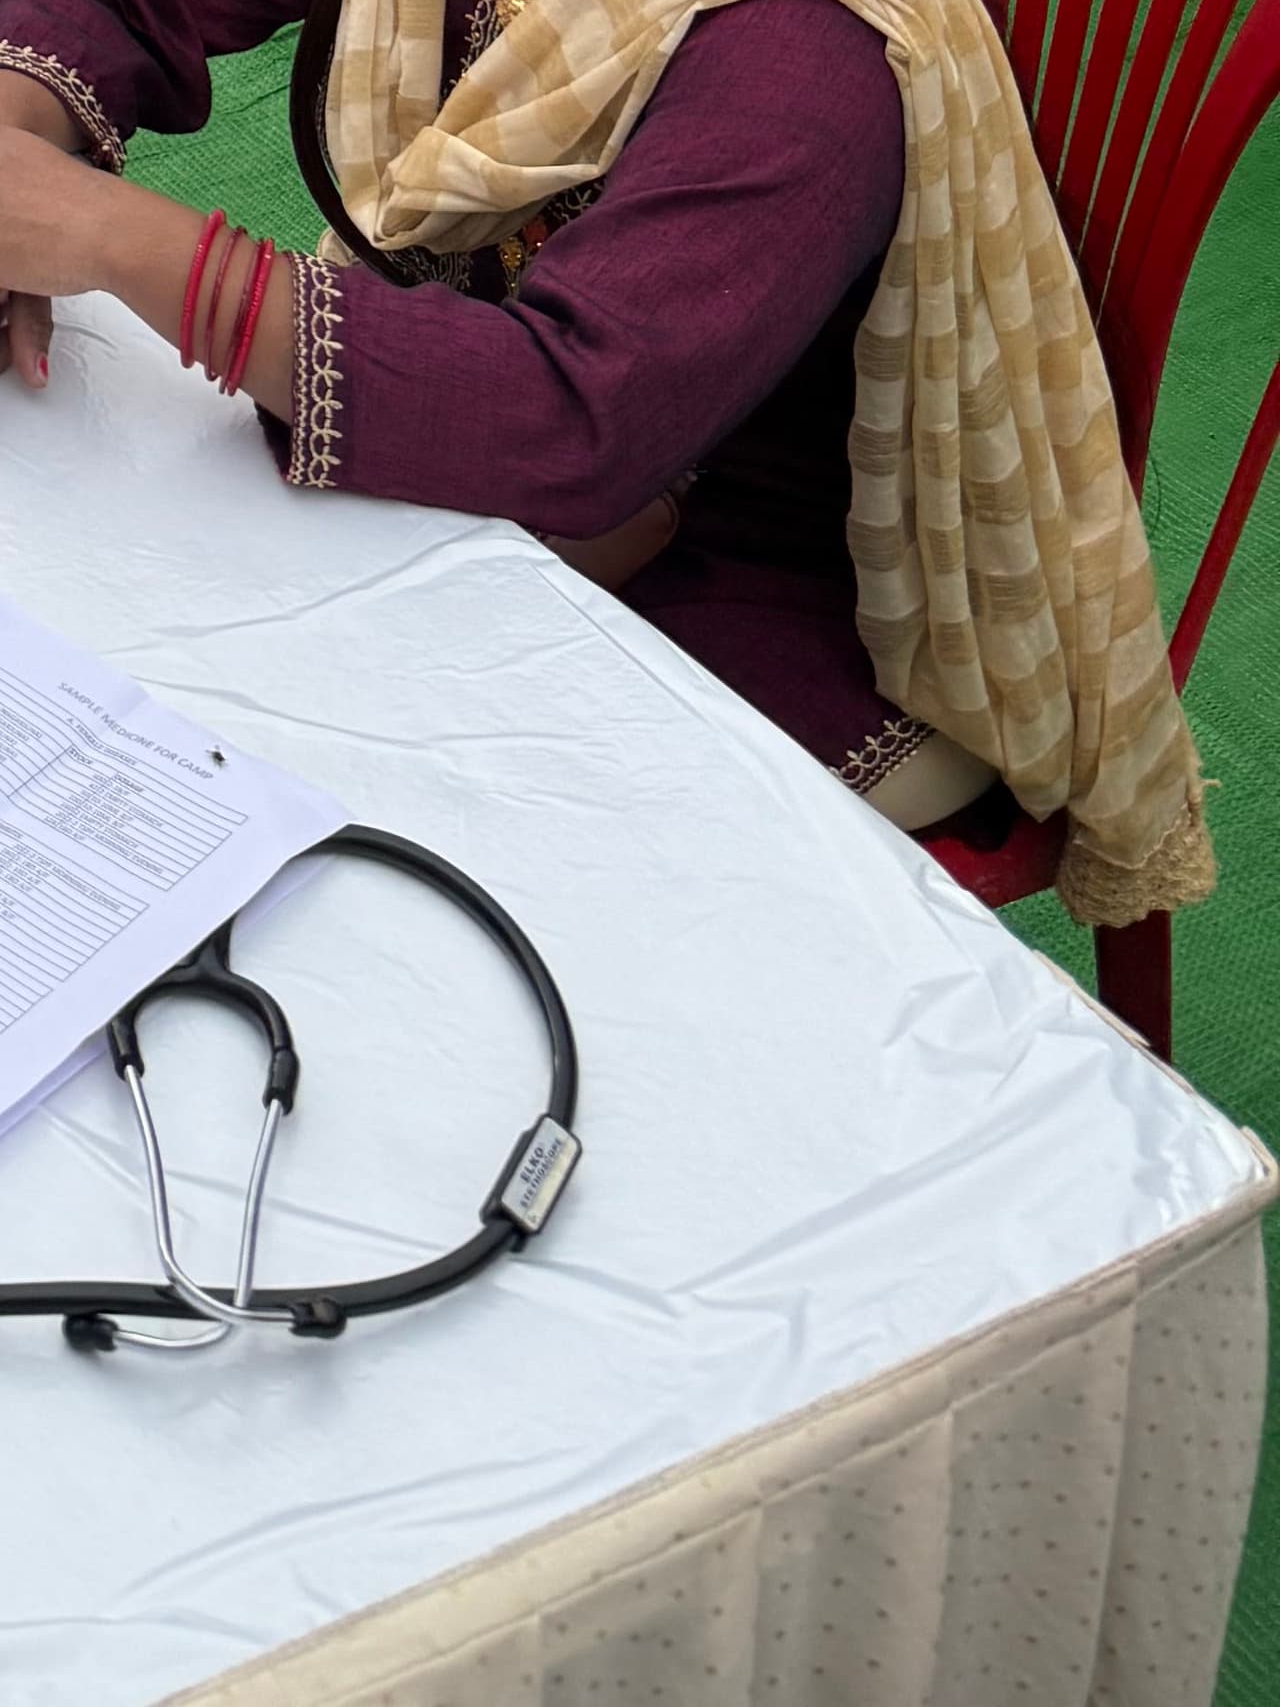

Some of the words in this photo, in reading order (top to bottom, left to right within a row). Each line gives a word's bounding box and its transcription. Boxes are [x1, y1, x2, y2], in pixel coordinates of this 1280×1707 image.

[57, 680, 105, 715] SAMPLE
[152, 744, 179, 761] FOR
[175, 756, 215, 782] CAMP
[514, 1137, 566, 1209] STETHOSCOPE
[517, 1144, 548, 1183] ELKO
